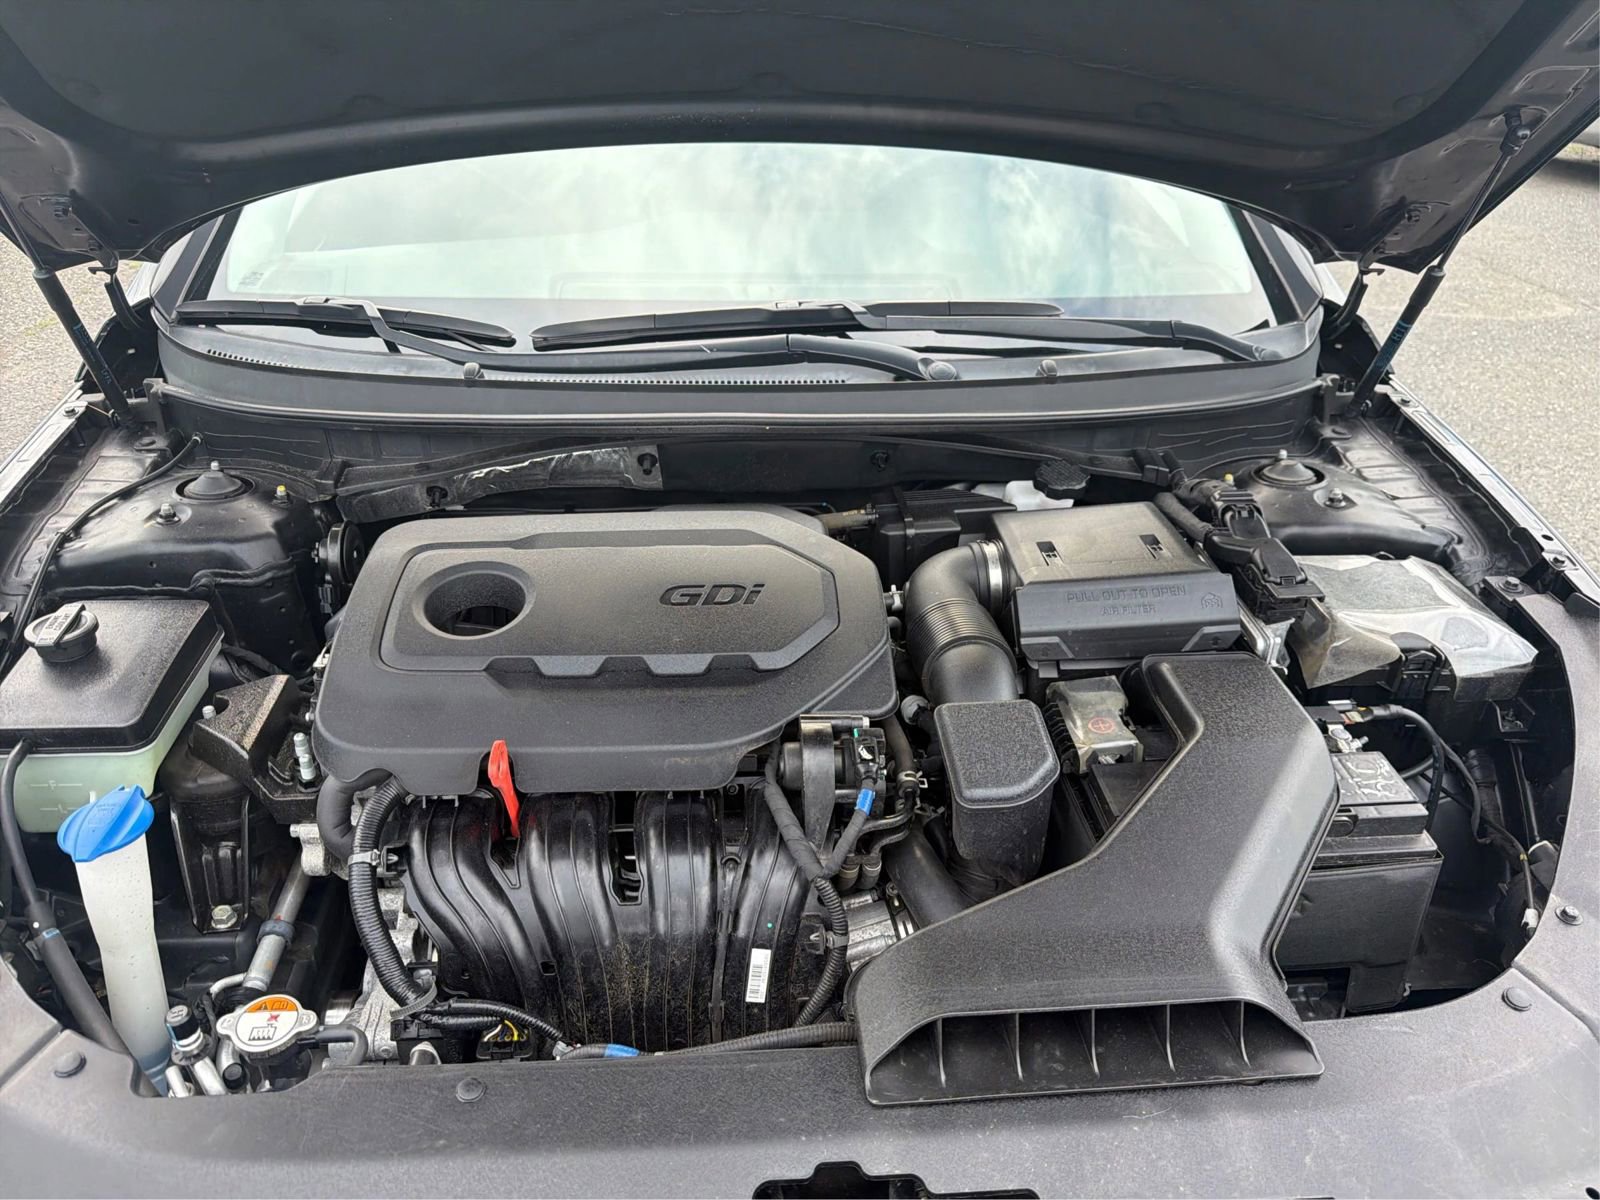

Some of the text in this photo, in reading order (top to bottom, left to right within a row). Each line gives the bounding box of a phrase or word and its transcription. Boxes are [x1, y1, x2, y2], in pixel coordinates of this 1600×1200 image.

[659, 583, 766, 606] GDi
[1066, 584, 1186, 603] PULL OUT TO OPEN
[1102, 604, 1157, 616] AIR FILTER
